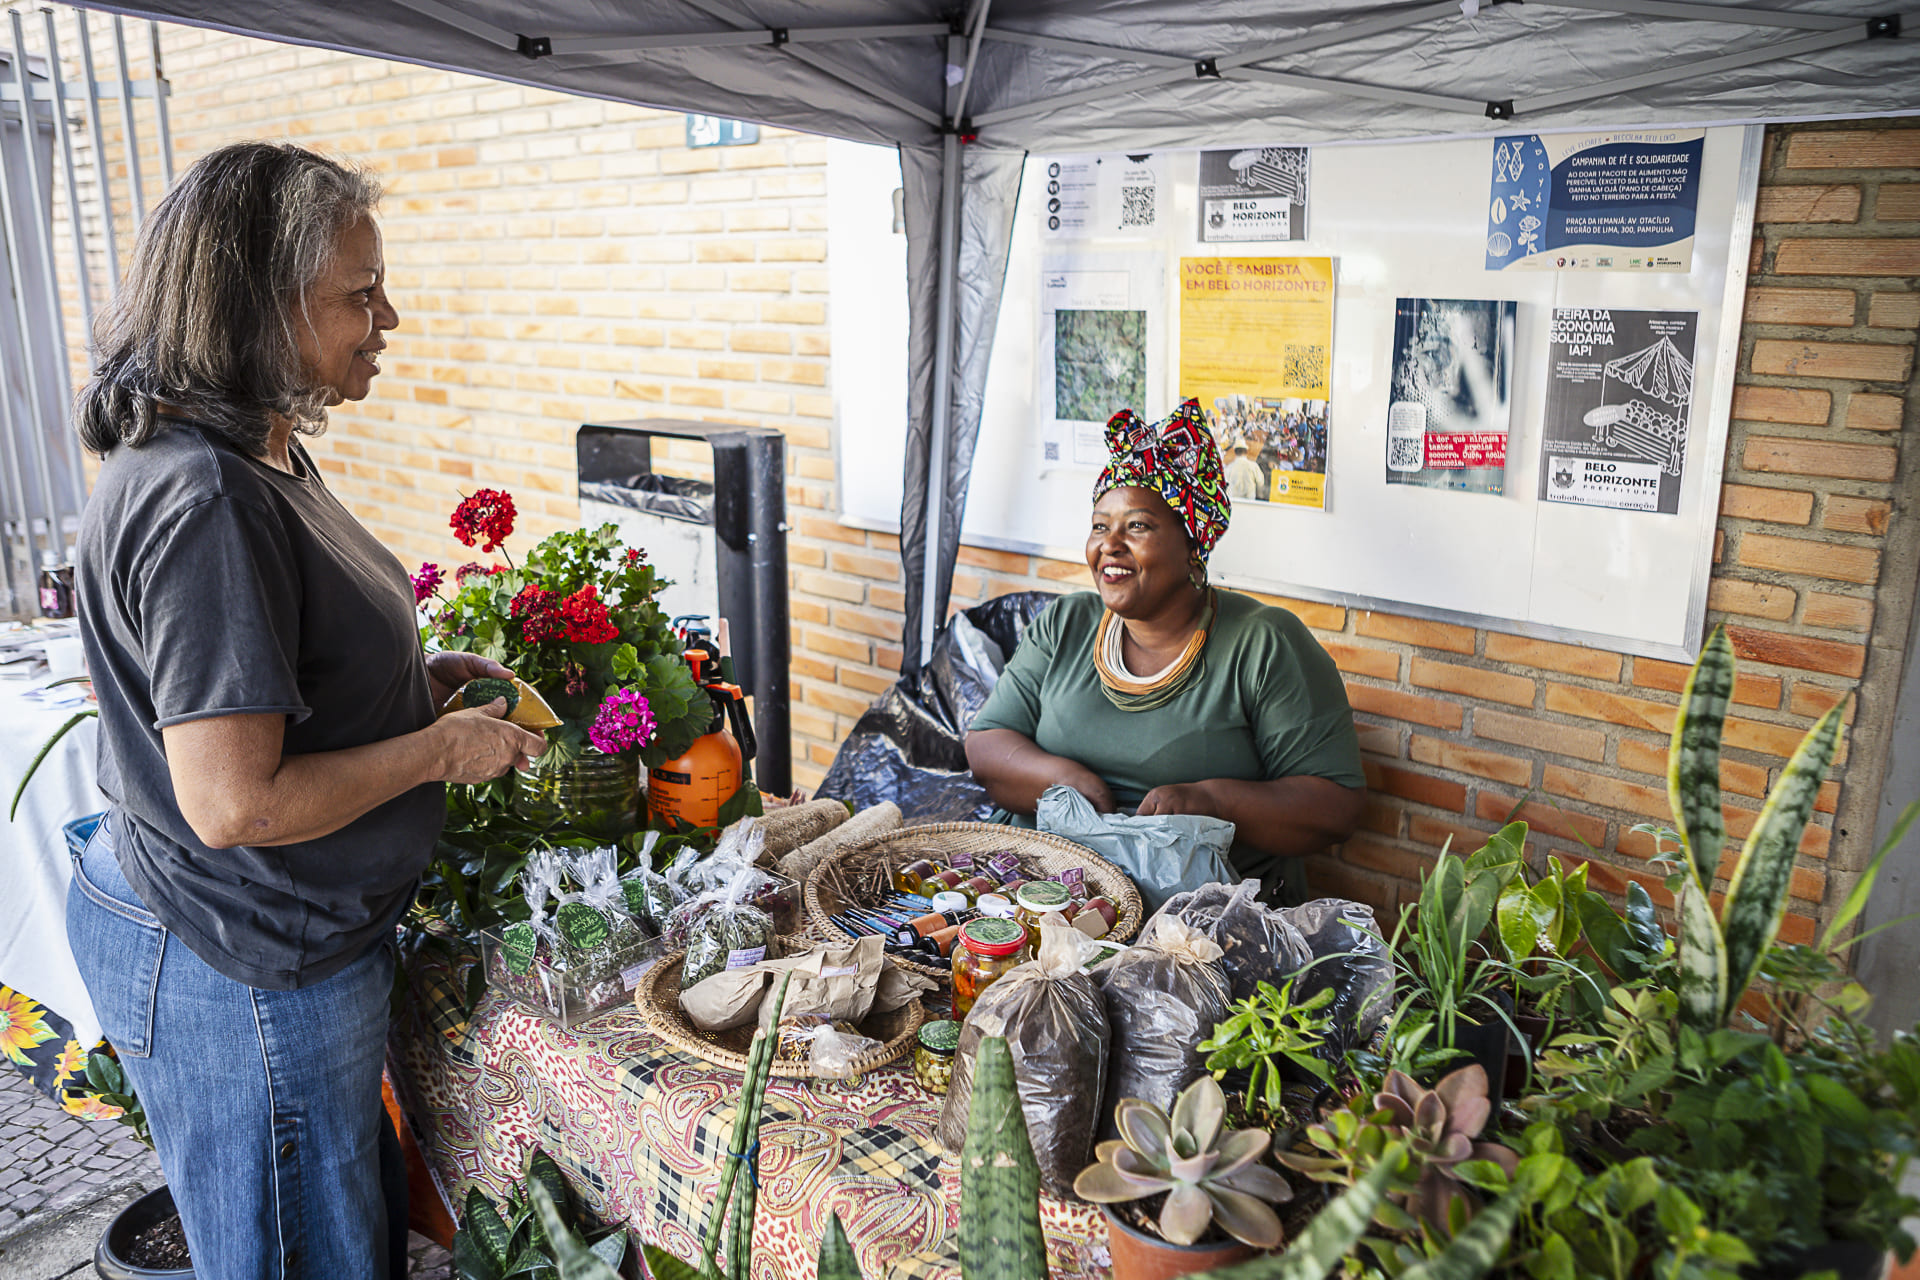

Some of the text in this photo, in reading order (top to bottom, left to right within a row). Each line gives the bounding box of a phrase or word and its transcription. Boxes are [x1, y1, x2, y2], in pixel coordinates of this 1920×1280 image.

[1572, 154, 1690, 167] CAMPANHA DE FÉ E SOLIDARIEDADE
[1566, 178, 1598, 186] PERECÍVEL
[1599, 178, 1626, 186] (EXCETO
[1646, 176, 1665, 184] FUBÁ)
[1667, 175, 1686, 183] VOCÊ
[1604, 184, 1617, 193] OJÁ
[1618, 184, 1640, 193] (PANO
[1651, 183, 1682, 193] CABEÇA)
[1233, 202, 1257, 210] BELO
[1233, 211, 1288, 220] HORIZONTE
[1566, 217, 1586, 226] PRAÇA
[1640, 216, 1670, 224] OTACÍLIO
[1565, 225, 1591, 234] NEGRÃO
[1602, 226, 1620, 234] LIMA,
[1186, 260, 1301, 276] VOCÊ É SAMBISTA
[1186, 279, 1326, 292] EM BELO HORIZONTE?
[1556, 309, 1611, 321] FEIRA DA
[1552, 320, 1615, 333] ECONOMIA
[1551, 331, 1614, 345] SOLIDÁRIA
[1569, 345, 1592, 356] IAPI
[1585, 462, 1617, 472] BELO
[1584, 474, 1657, 488] HORIZONTE
[1583, 485, 1656, 496] PREFEITURA
[1550, 493, 1584, 502] trabalho
[1619, 501, 1655, 510] coração
